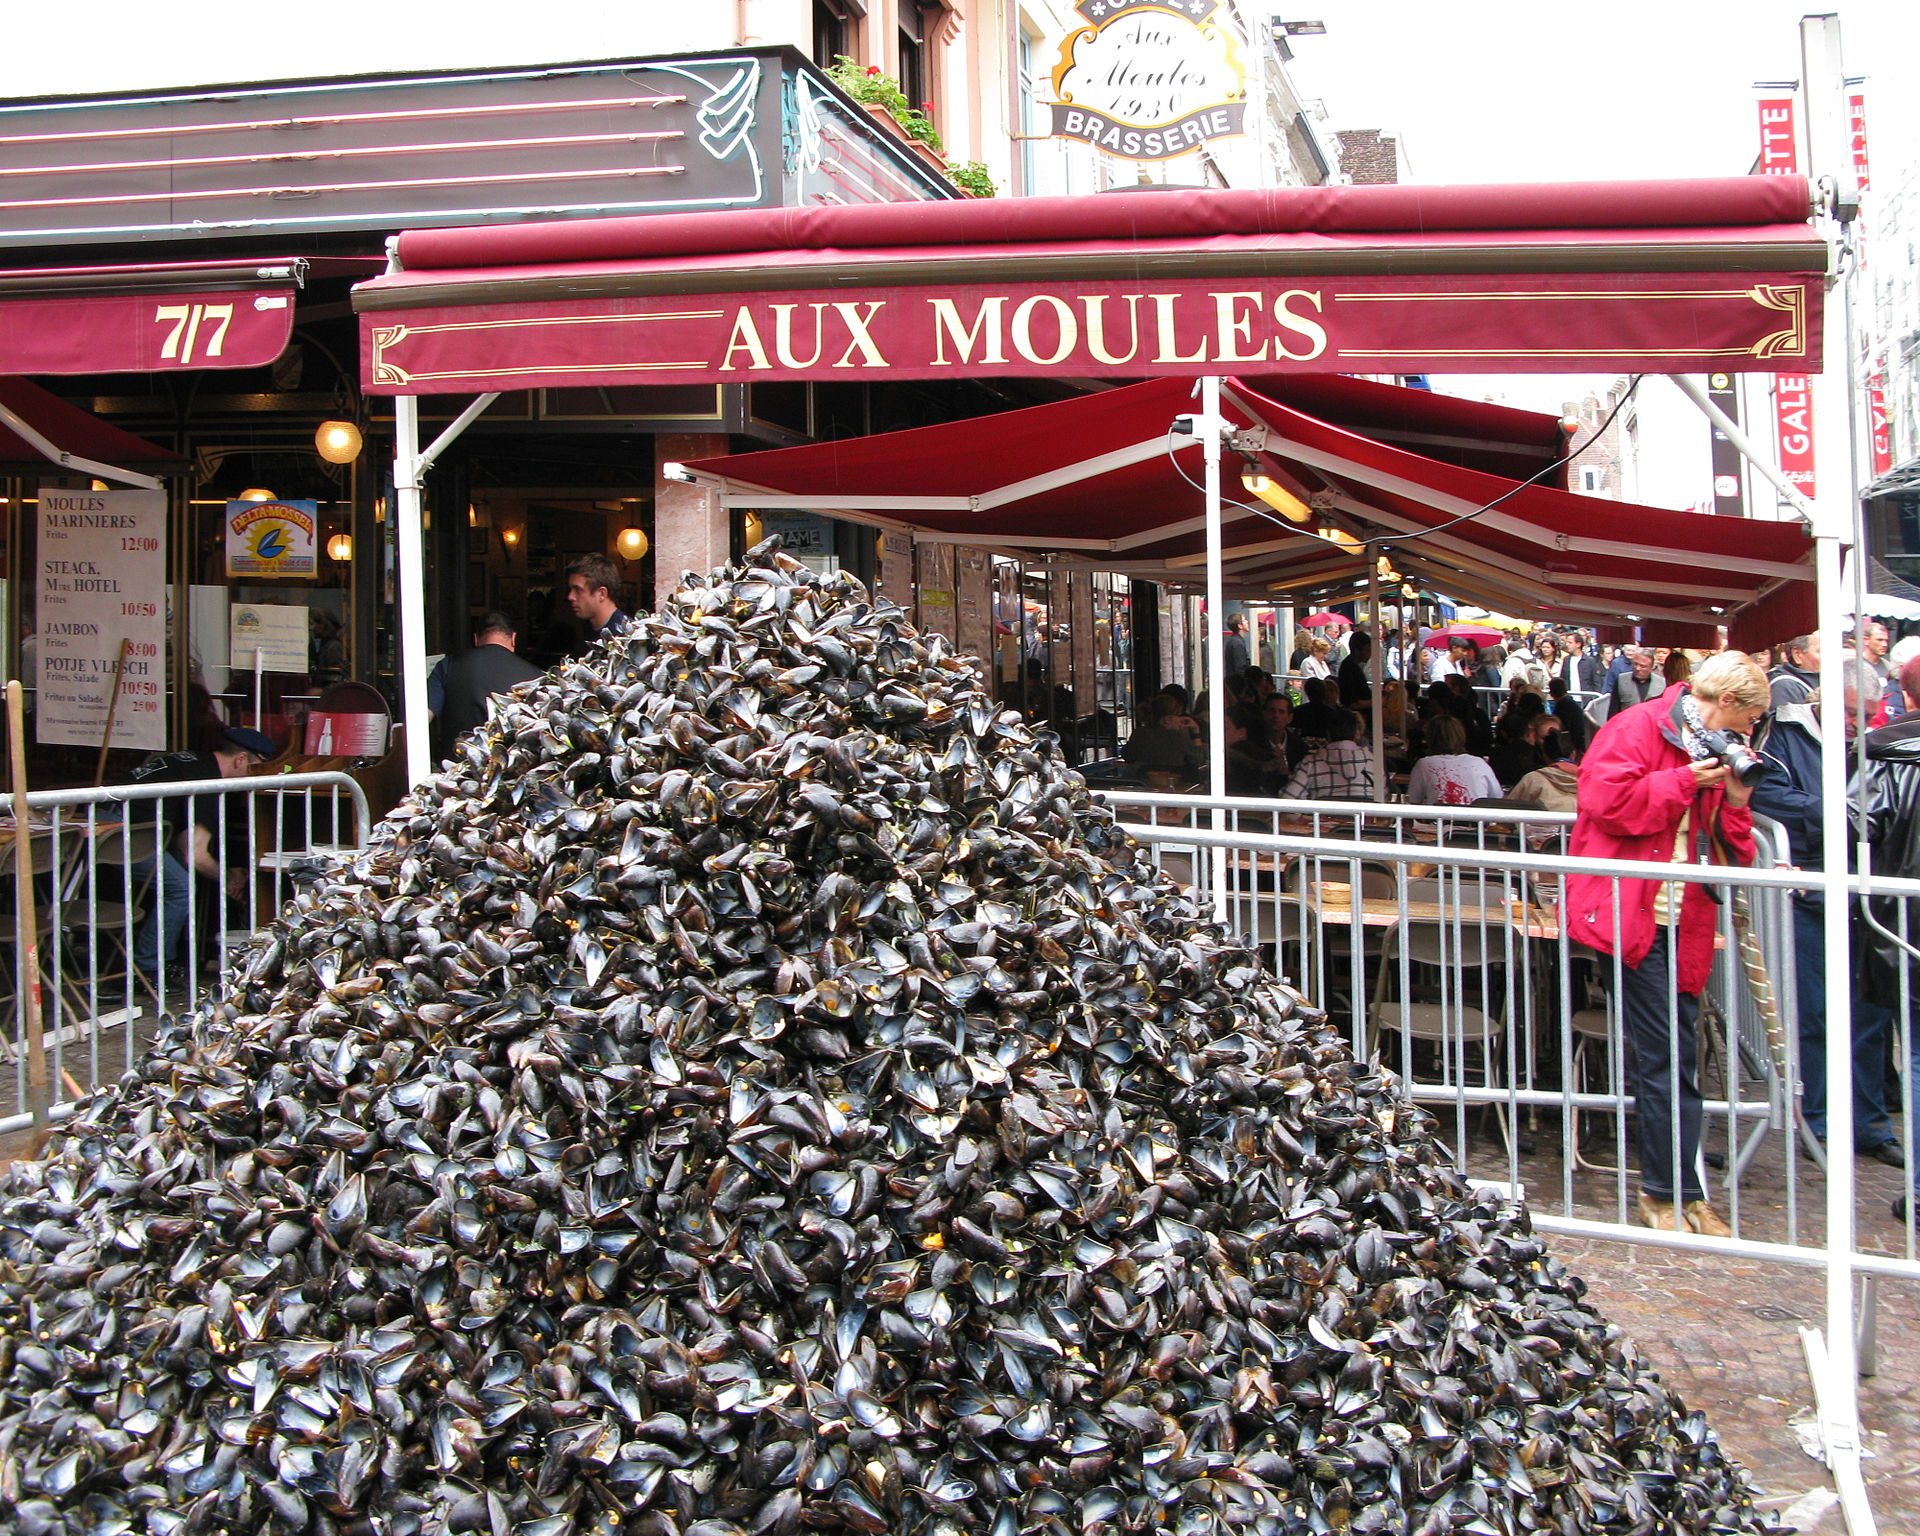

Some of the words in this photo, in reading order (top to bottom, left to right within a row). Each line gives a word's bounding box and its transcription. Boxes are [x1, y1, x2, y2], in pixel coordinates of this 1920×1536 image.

[1086, 59, 1206, 87] Moules
[1110, 94, 1182, 120] 1930
[1064, 109, 1231, 156] BRASSERIE
[154, 302, 233, 364] 7/7
[718, 301, 890, 371] AUX
[926, 289, 1329, 367] MOULES
[45, 497, 105, 511] MOULES
[45, 514, 137, 529] MARINIERES
[46, 530, 68, 539] Frites
[74, 578, 121, 593] HOTEL
[44, 595, 67, 604] Frites
[44, 622, 99, 636] JAMBON
[46, 638, 68, 648] Frites
[44, 657, 87, 672] POTJE
